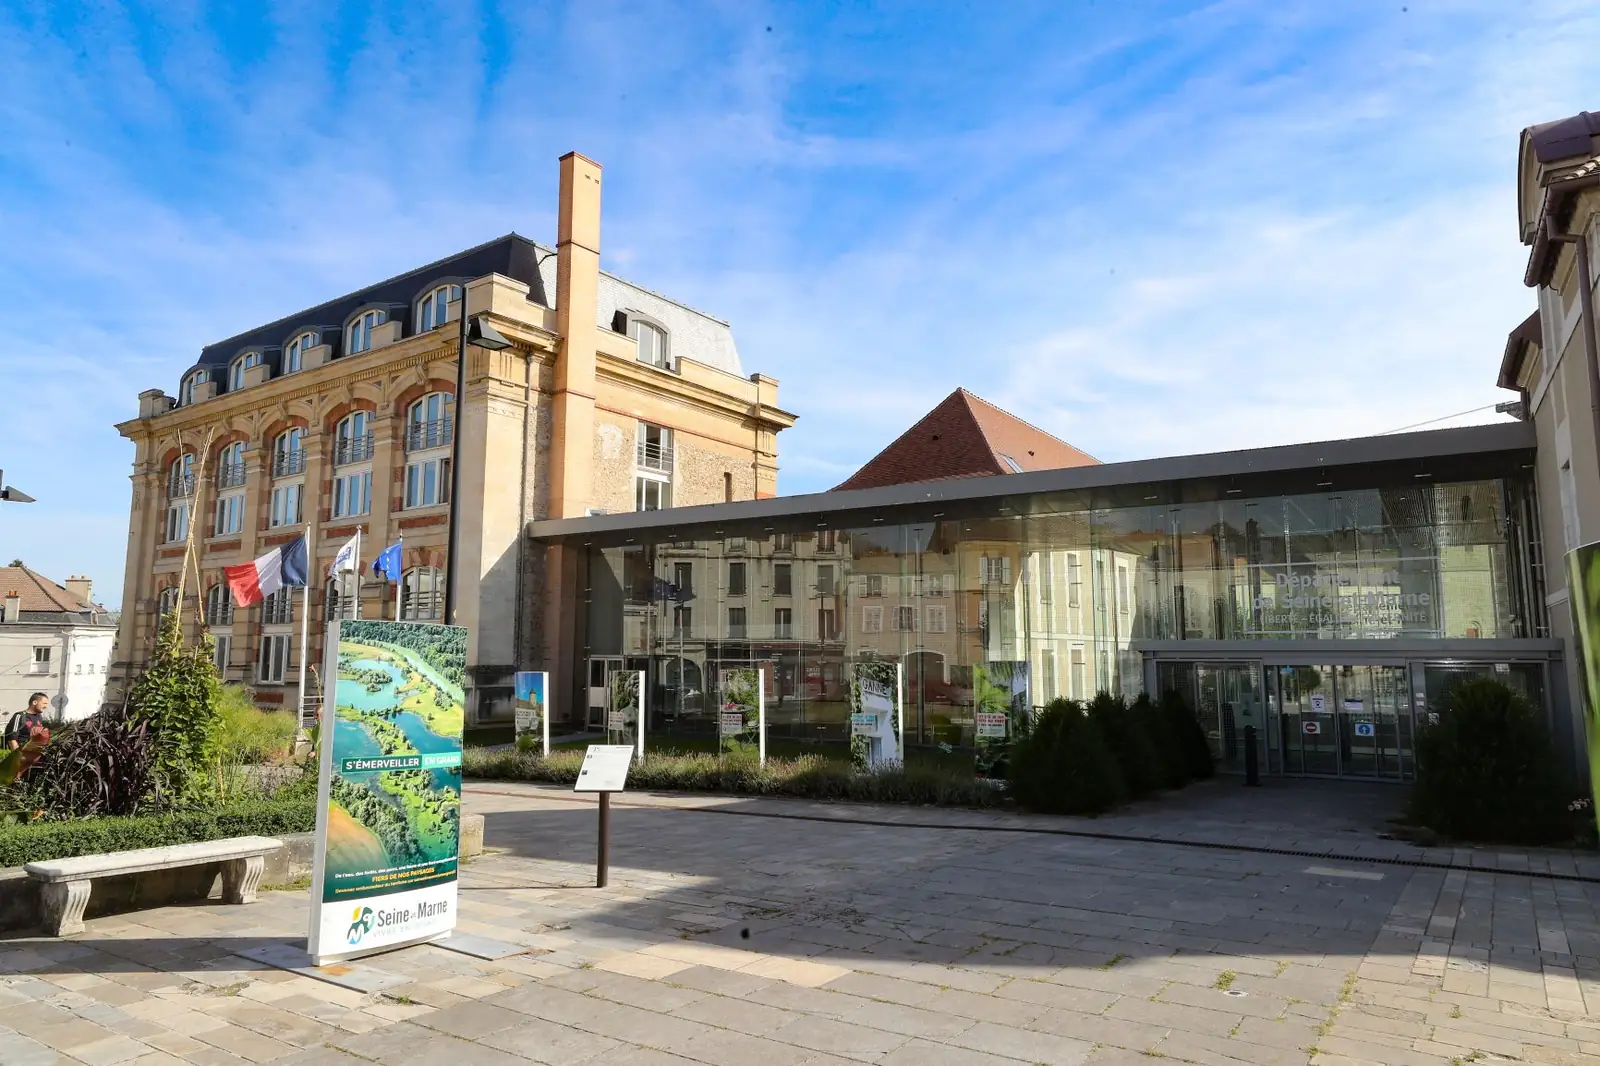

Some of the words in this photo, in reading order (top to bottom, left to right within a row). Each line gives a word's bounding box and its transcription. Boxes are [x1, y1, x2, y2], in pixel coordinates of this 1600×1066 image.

[346, 758, 419, 770] S'ÉMERVEILLER
[377, 908, 410, 927] Seine
[417, 900, 448, 919] Marne
